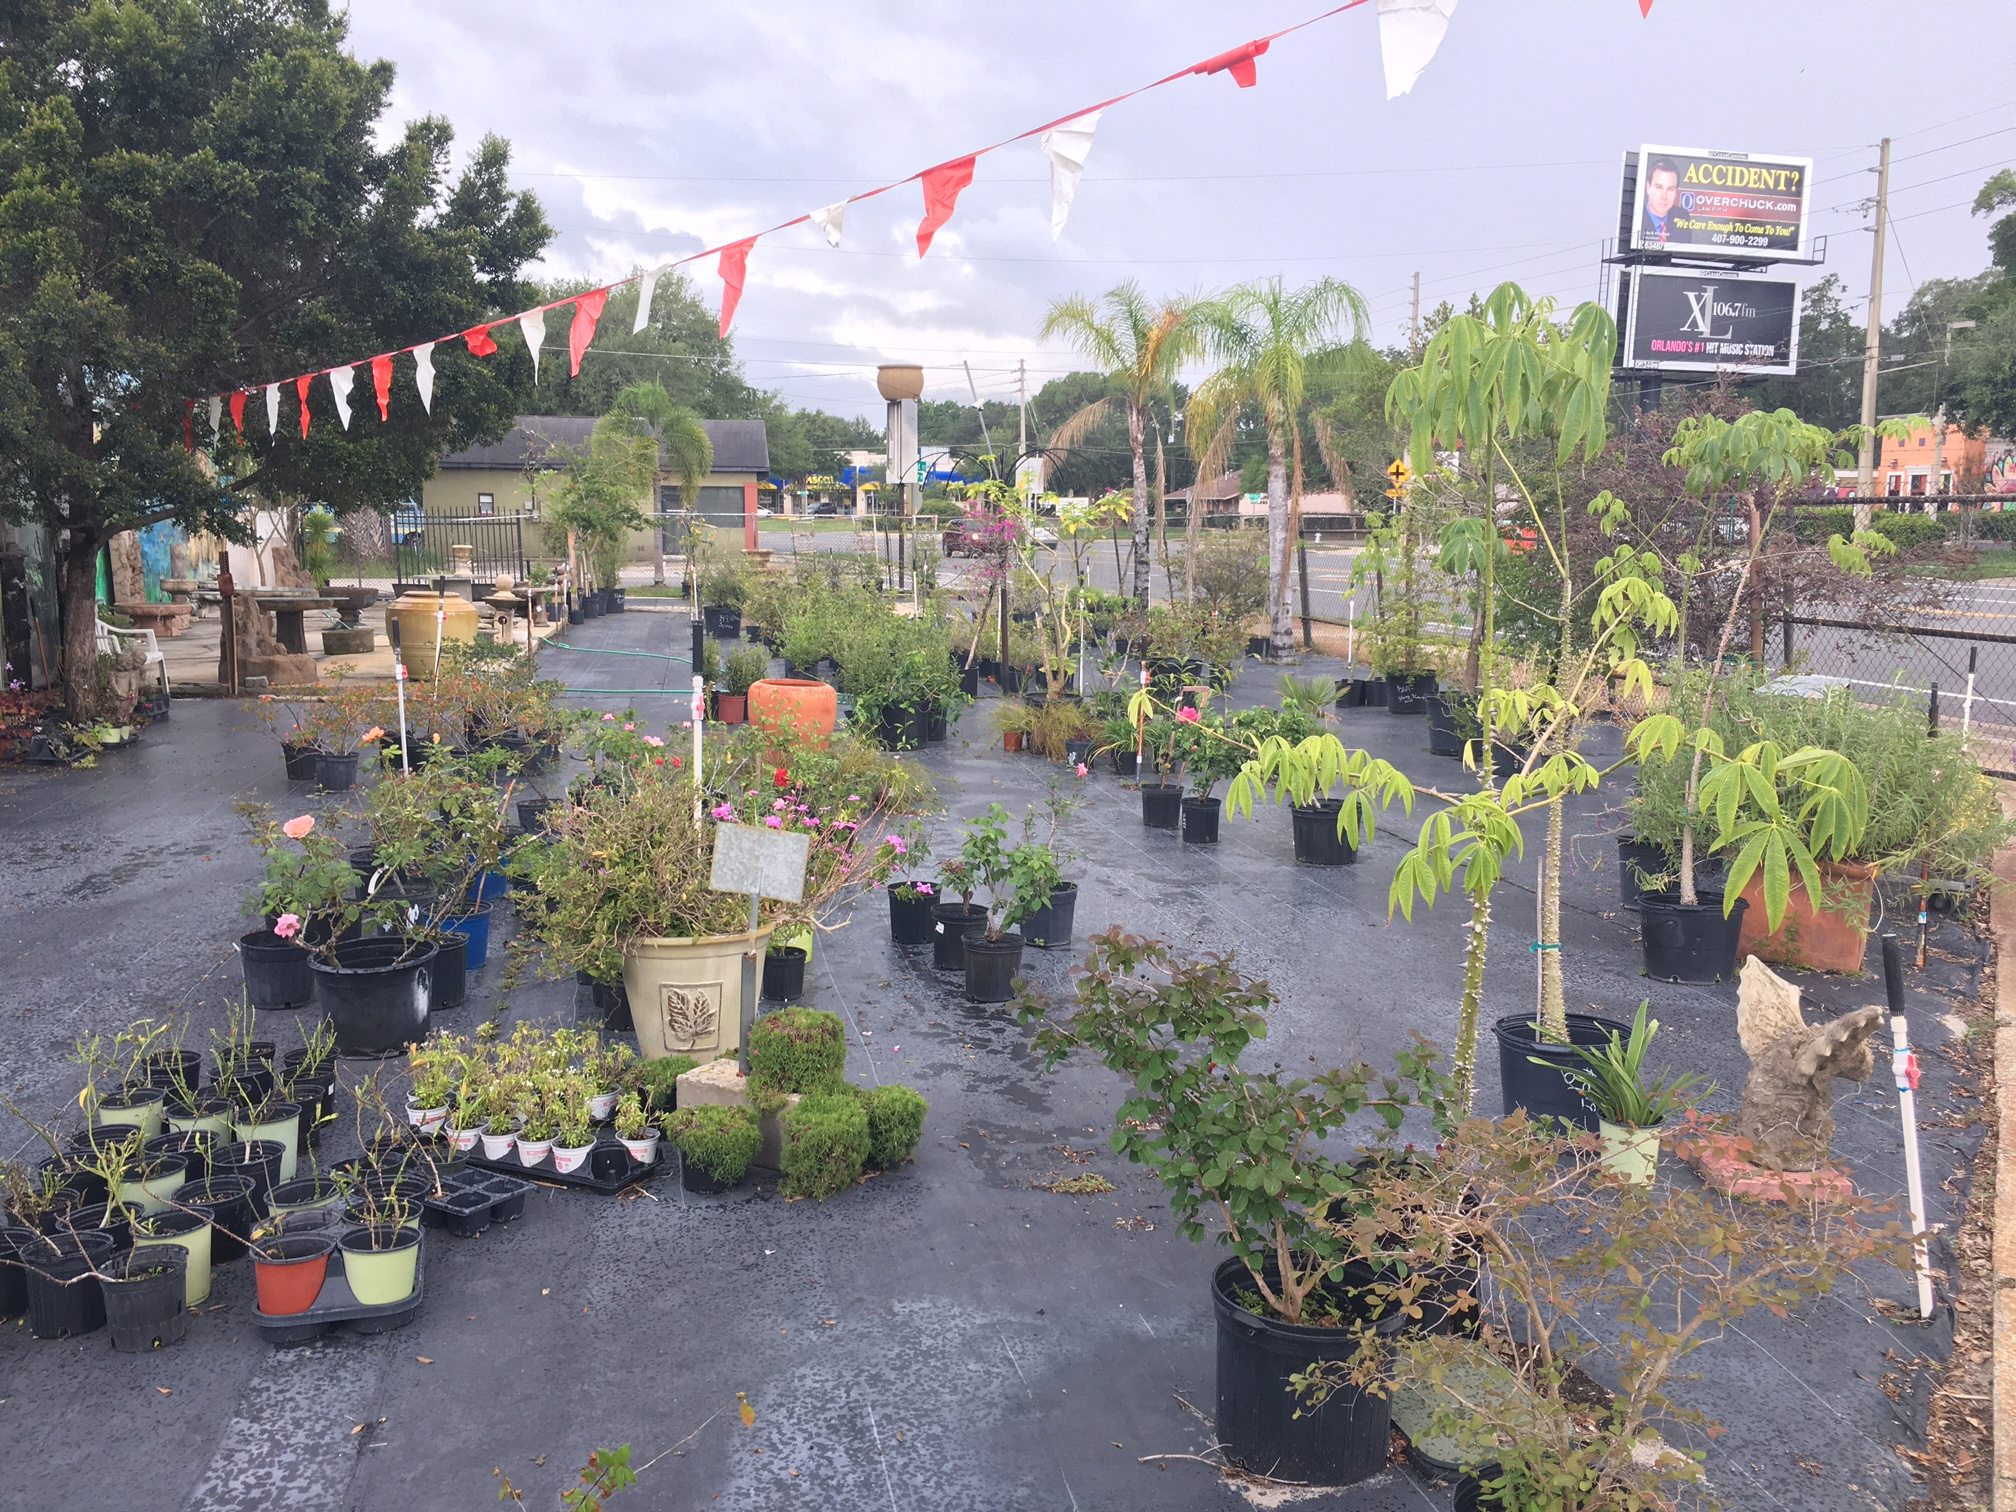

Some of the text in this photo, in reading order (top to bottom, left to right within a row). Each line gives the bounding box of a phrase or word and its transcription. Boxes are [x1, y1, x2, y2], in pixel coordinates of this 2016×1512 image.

[1683, 163, 1800, 192] ACCIDENT?
[1696, 195, 1796, 212] OVERCHUCK.com
[1689, 219, 1706, 230] Care
[1707, 221, 1733, 233] Enough
[1735, 223, 1744, 233] To
[1745, 224, 1764, 234] Come
[1765, 225, 1774, 235] To
[1712, 233, 1769, 247] 407-900-2299
[1680, 285, 1733, 339] XL
[1651, 339, 1693, 353] ORLANDO'S
[1706, 342, 1719, 353] HIT
[1719, 343, 1743, 355] MUSIC
[1744, 344, 1775, 356] STATION
